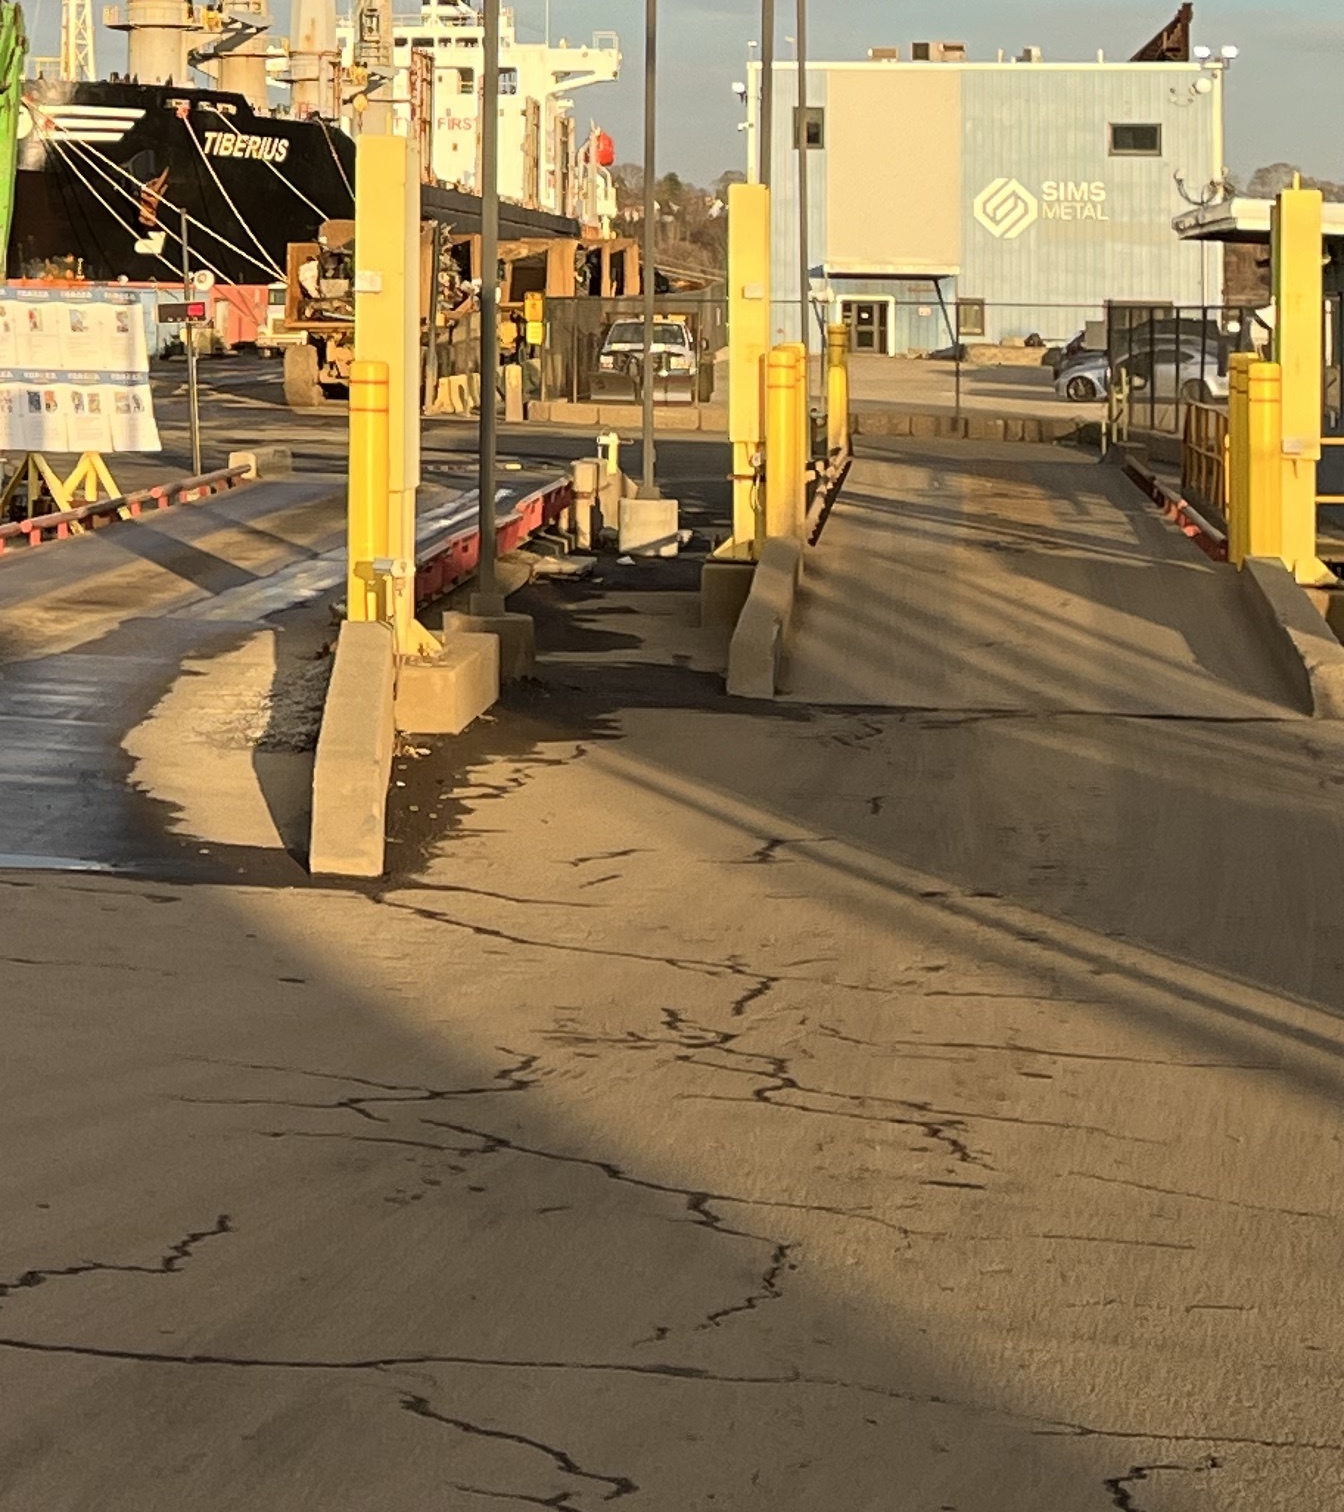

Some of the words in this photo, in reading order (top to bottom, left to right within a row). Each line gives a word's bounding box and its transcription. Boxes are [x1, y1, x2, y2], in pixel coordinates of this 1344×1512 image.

[203, 131, 289, 162] TIBERIUS
[1042, 181, 1106, 201] SIMS
[1042, 201, 1109, 220] METAL
